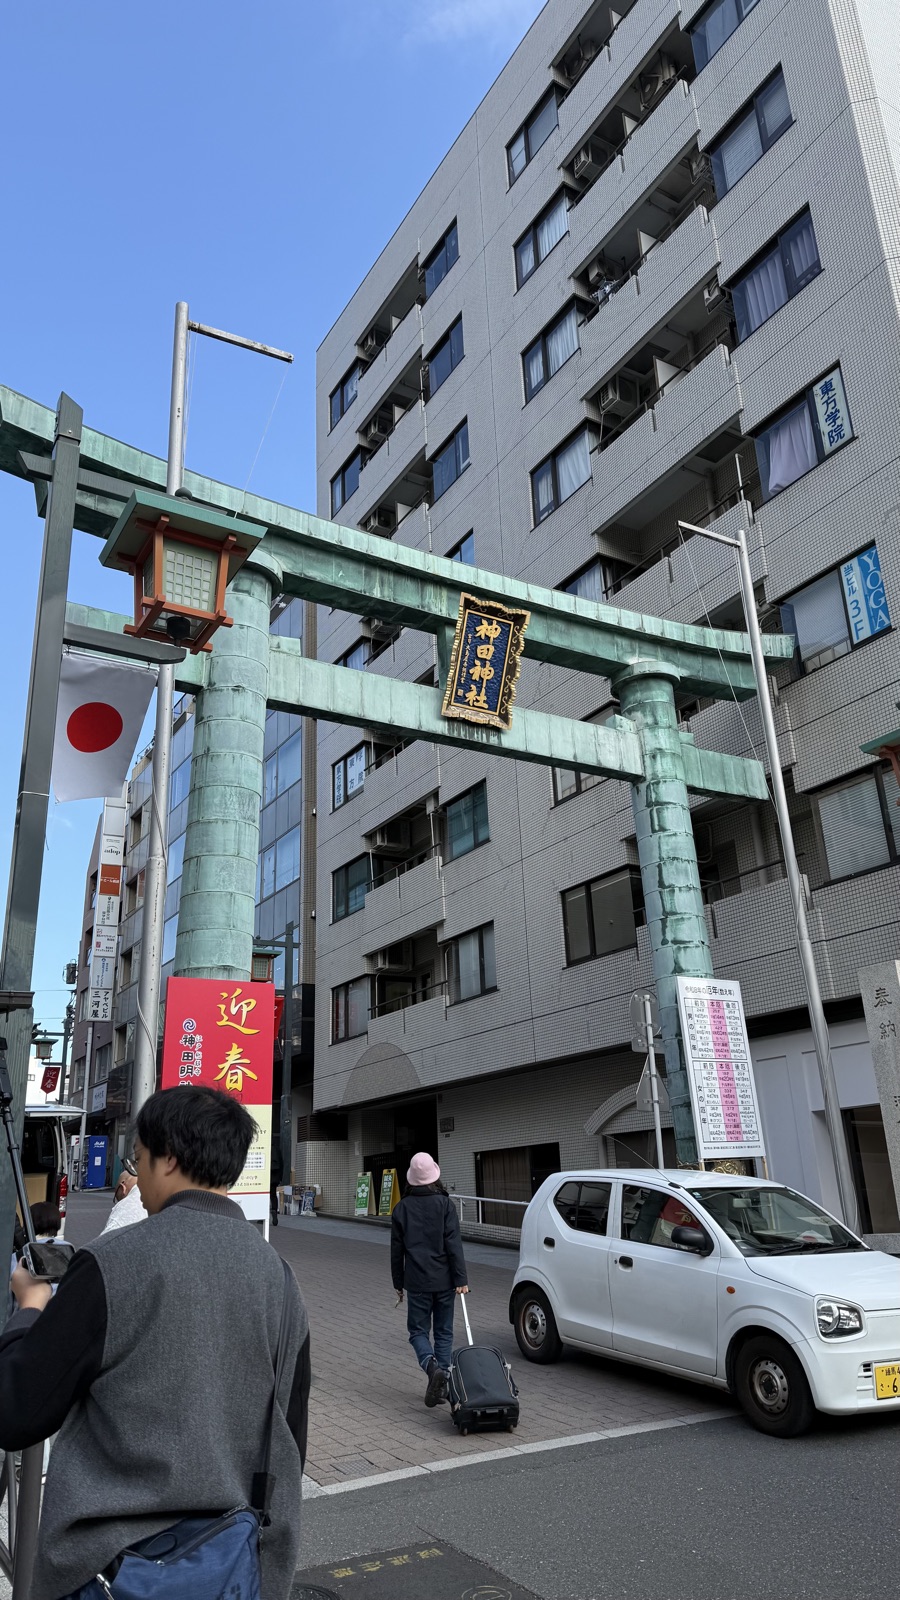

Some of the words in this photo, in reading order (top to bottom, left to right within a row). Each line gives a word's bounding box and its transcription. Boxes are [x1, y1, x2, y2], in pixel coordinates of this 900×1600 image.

[819, 377, 846, 447] 東方学院
[861, 548, 891, 632] YOGA
[464, 618, 502, 709] 神田神社
[91, 990, 101, 1018] 三河屋
[213, 987, 261, 1092] 迎春
[873, 986, 897, 1040] 奉納
